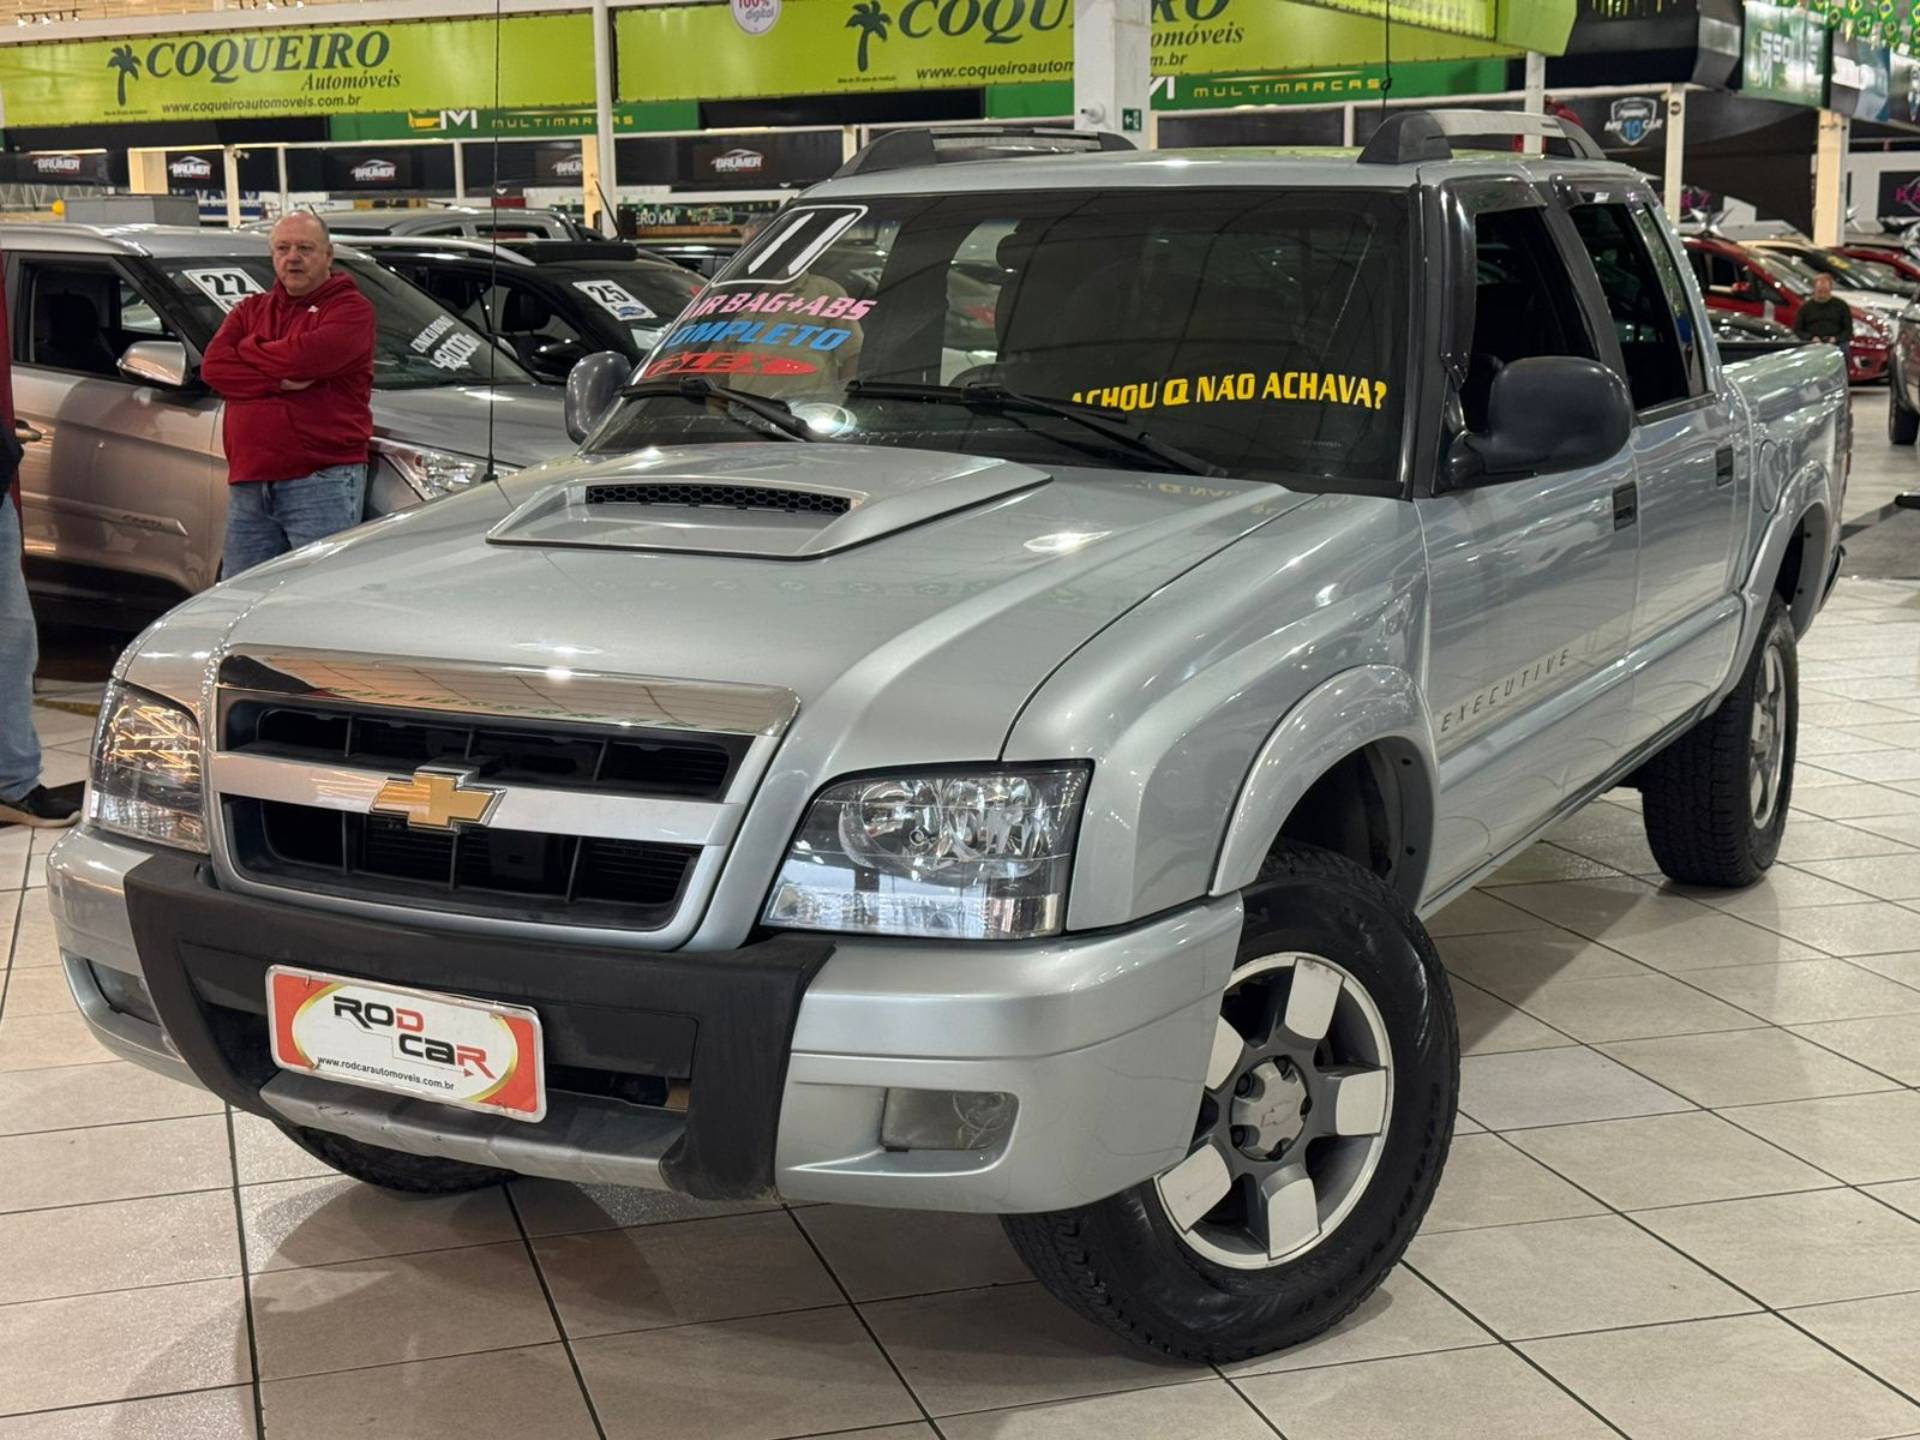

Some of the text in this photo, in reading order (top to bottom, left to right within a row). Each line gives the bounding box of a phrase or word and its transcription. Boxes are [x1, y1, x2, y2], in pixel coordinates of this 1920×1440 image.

[146, 30, 390, 83] COQUEIRO
[301, 69, 401, 92] Automóveis
[1193, 78, 1382, 97] MULTIMARCAS
[161, 94, 361, 114] www.coqueiroautomoveis.com.br
[491, 114, 634, 129] MULTIMARAS
[659, 212, 677, 225] KM
[748, 211, 857, 276] 11
[201, 273, 257, 296] 22
[587, 285, 630, 303] 25
[1163, 378, 1189, 405] Q
[1196, 373, 1255, 402] NÃO
[1262, 371, 1387, 410] ACHAVA?
[1441, 648, 1569, 732] EXECUTIVE
[333, 995, 424, 1032] ROD
[317, 1055, 455, 1090] www.rodcarautomoveis.com.br
